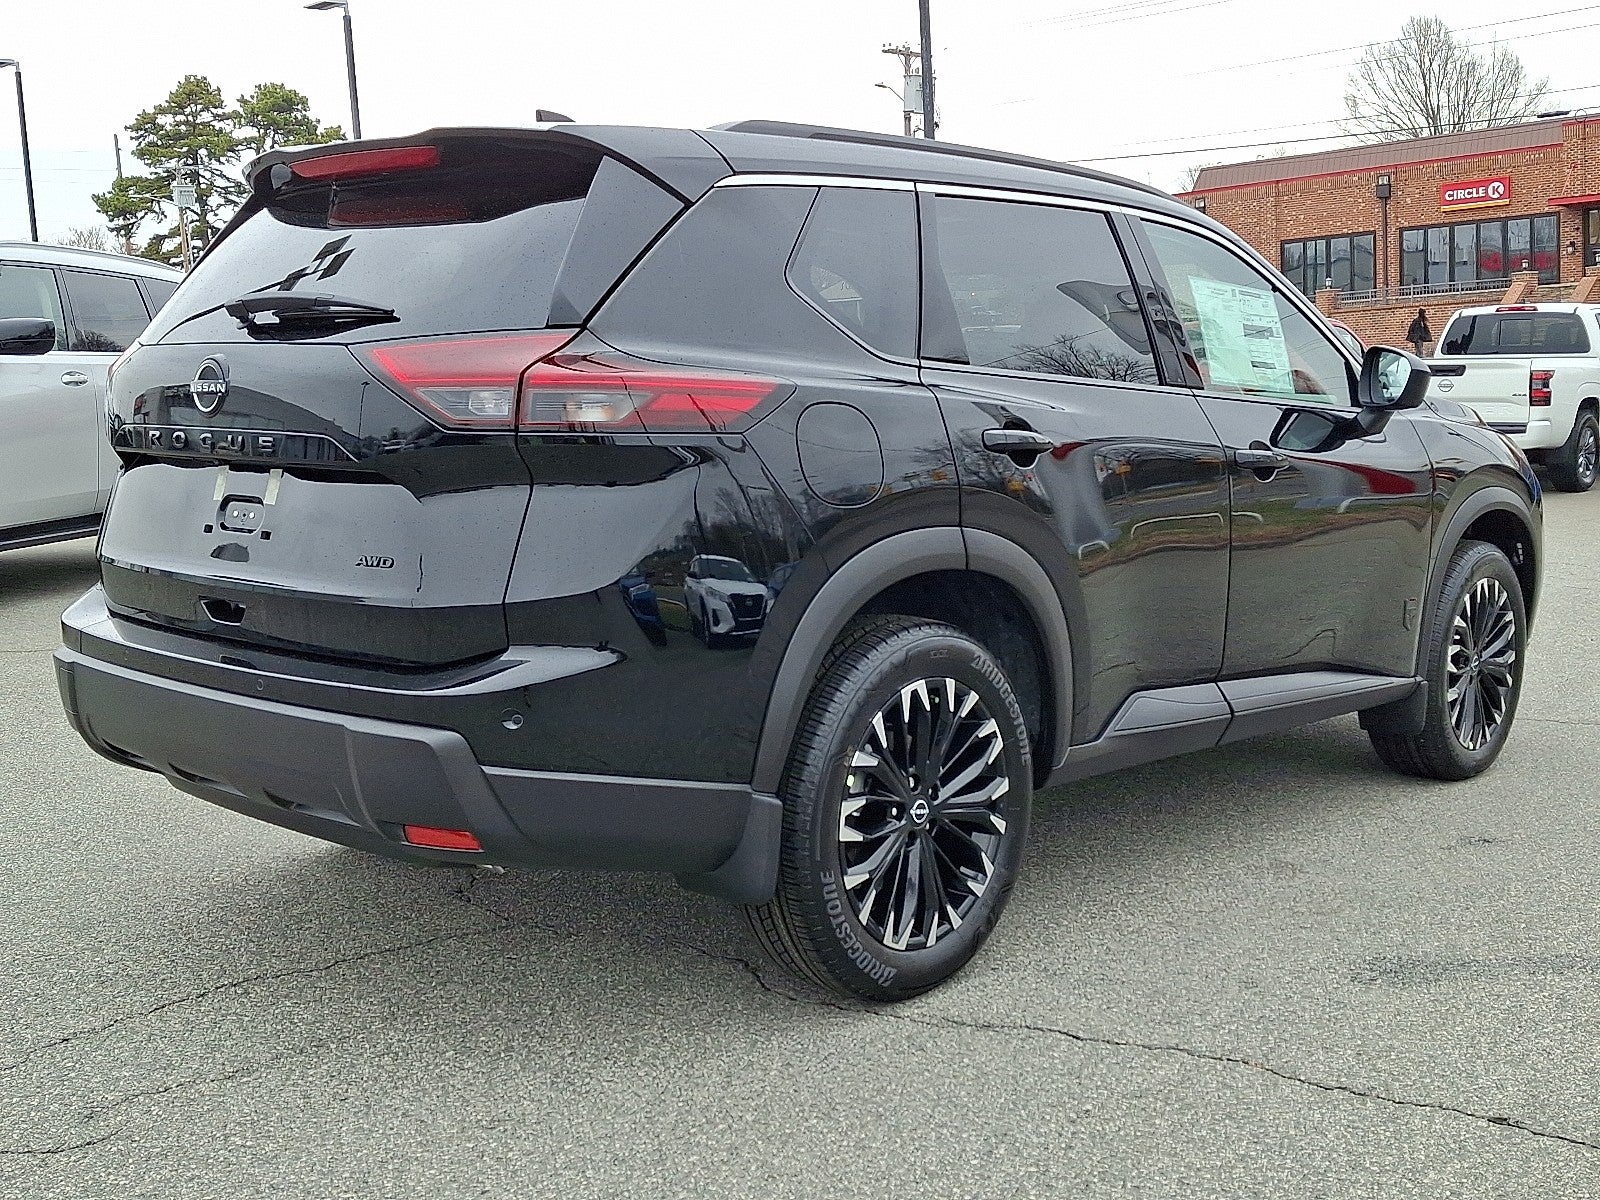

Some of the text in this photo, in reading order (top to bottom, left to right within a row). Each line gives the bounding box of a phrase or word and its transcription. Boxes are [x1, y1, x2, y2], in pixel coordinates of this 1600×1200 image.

[1445, 183, 1502, 200] CIRCLE K
[190, 382, 226, 393] NISSAN
[149, 430, 275, 453] ROGUE
[355, 554, 395, 569] AWD
[820, 869, 898, 988] BRIDGESTONE
